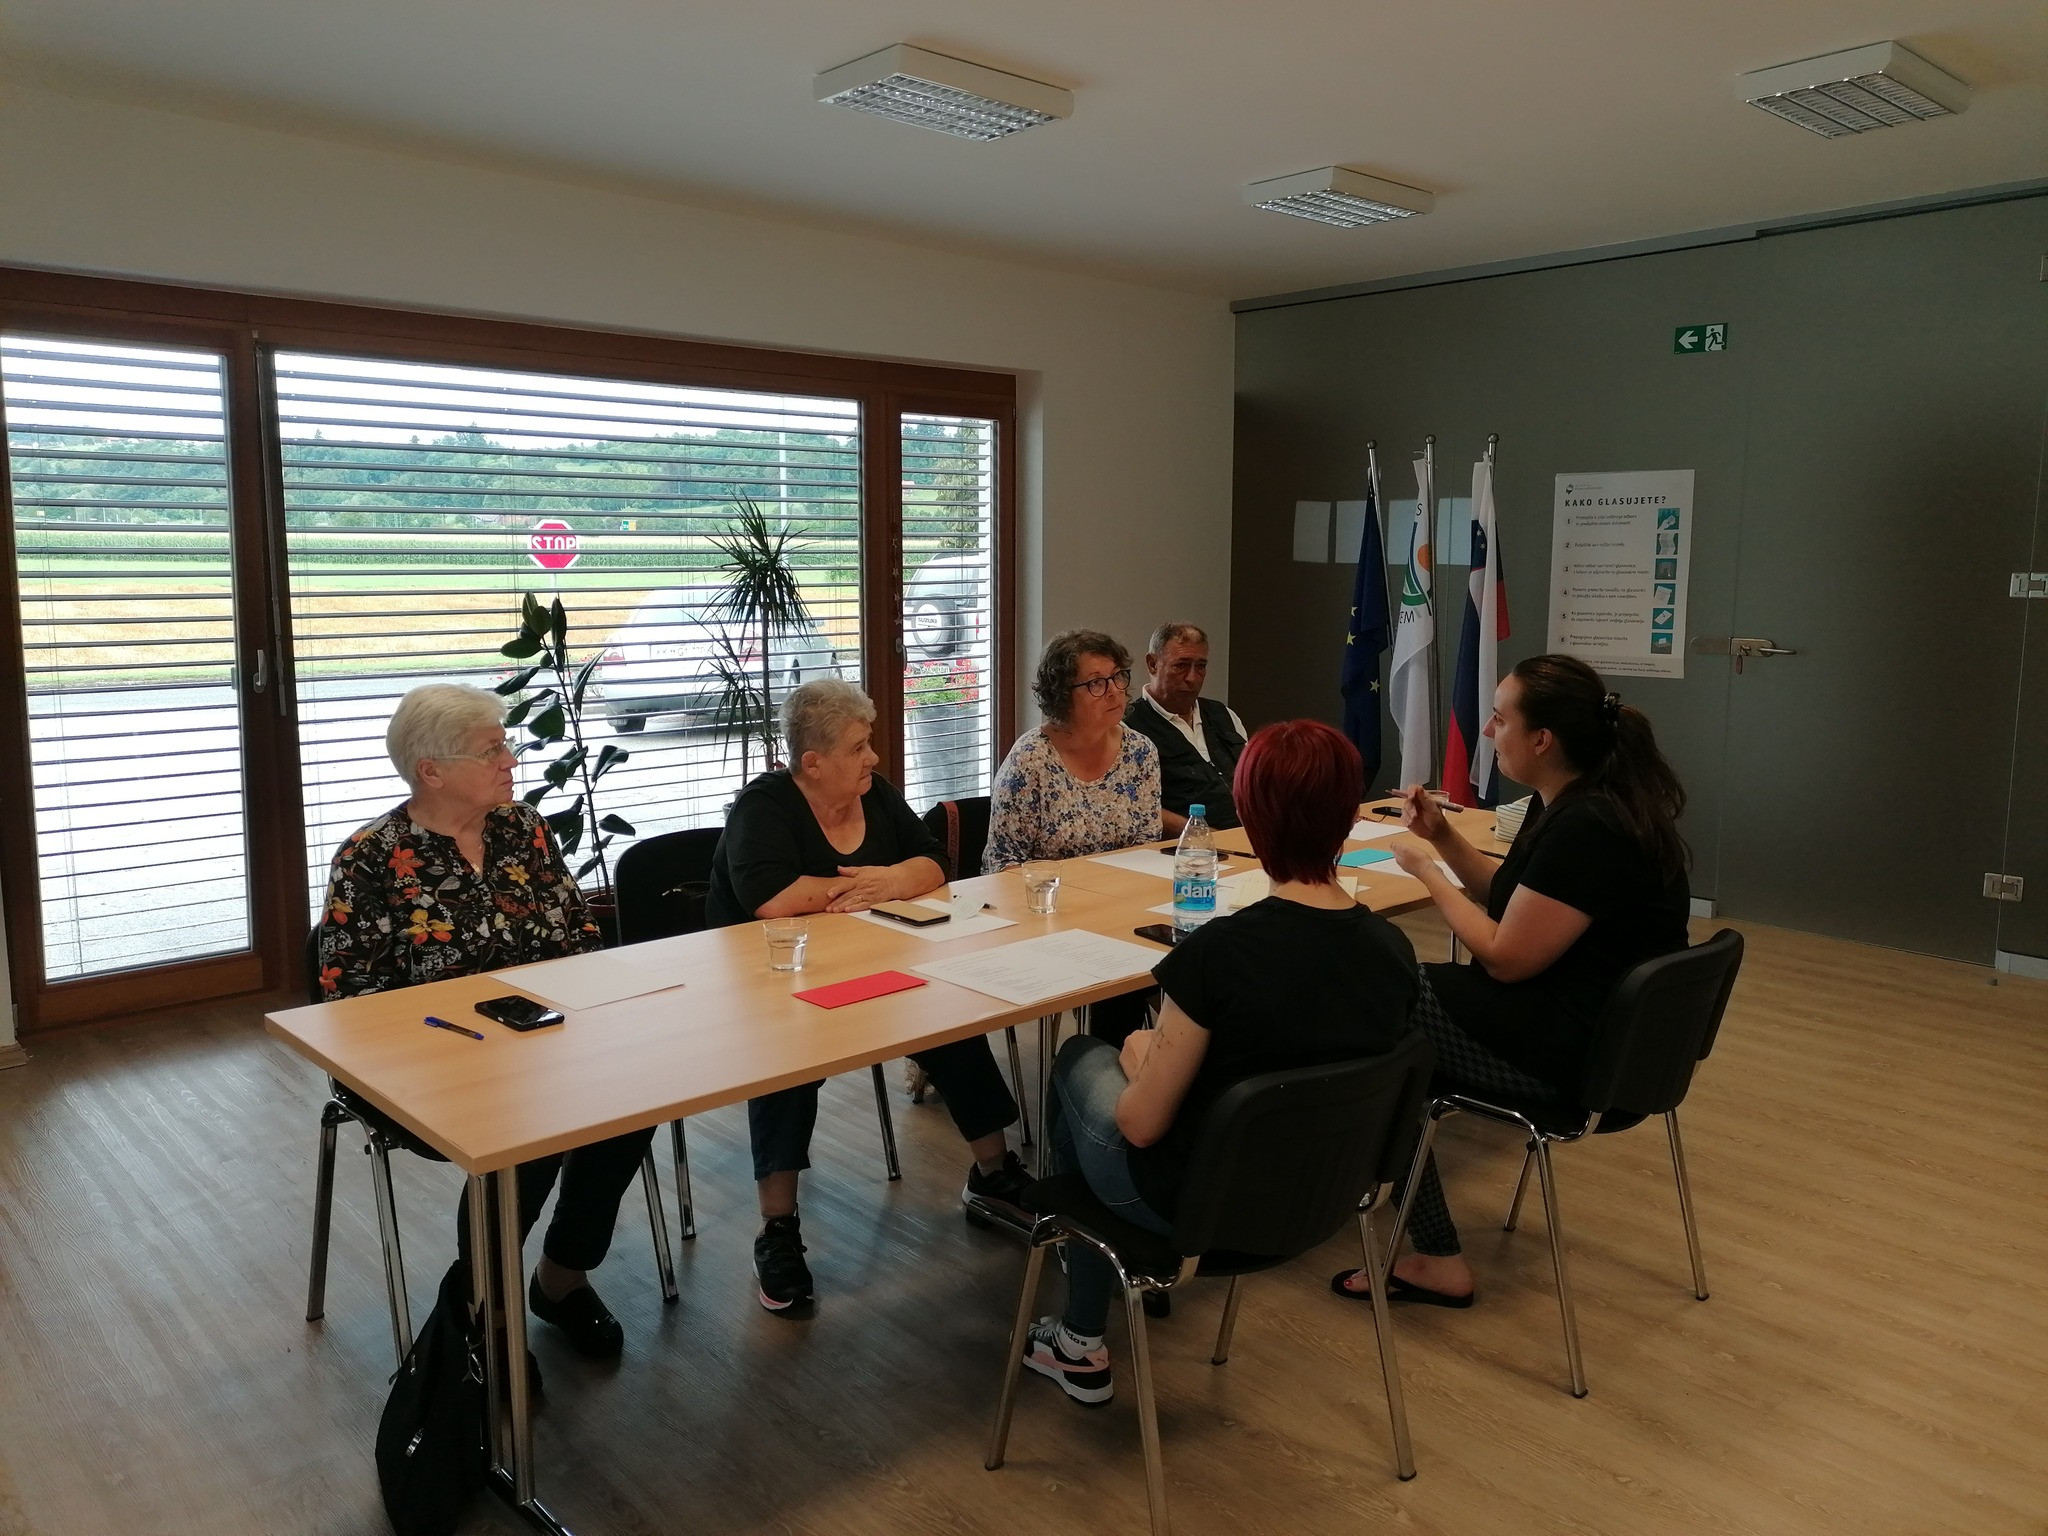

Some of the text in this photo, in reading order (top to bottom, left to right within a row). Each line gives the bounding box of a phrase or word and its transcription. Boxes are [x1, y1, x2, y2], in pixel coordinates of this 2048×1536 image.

[1565, 496, 1667, 507] KAKO GLASUJETE?
[1416, 503, 1423, 516] S
[530, 535, 577, 550] STOP
[918, 616, 938, 624] SUZUKI
